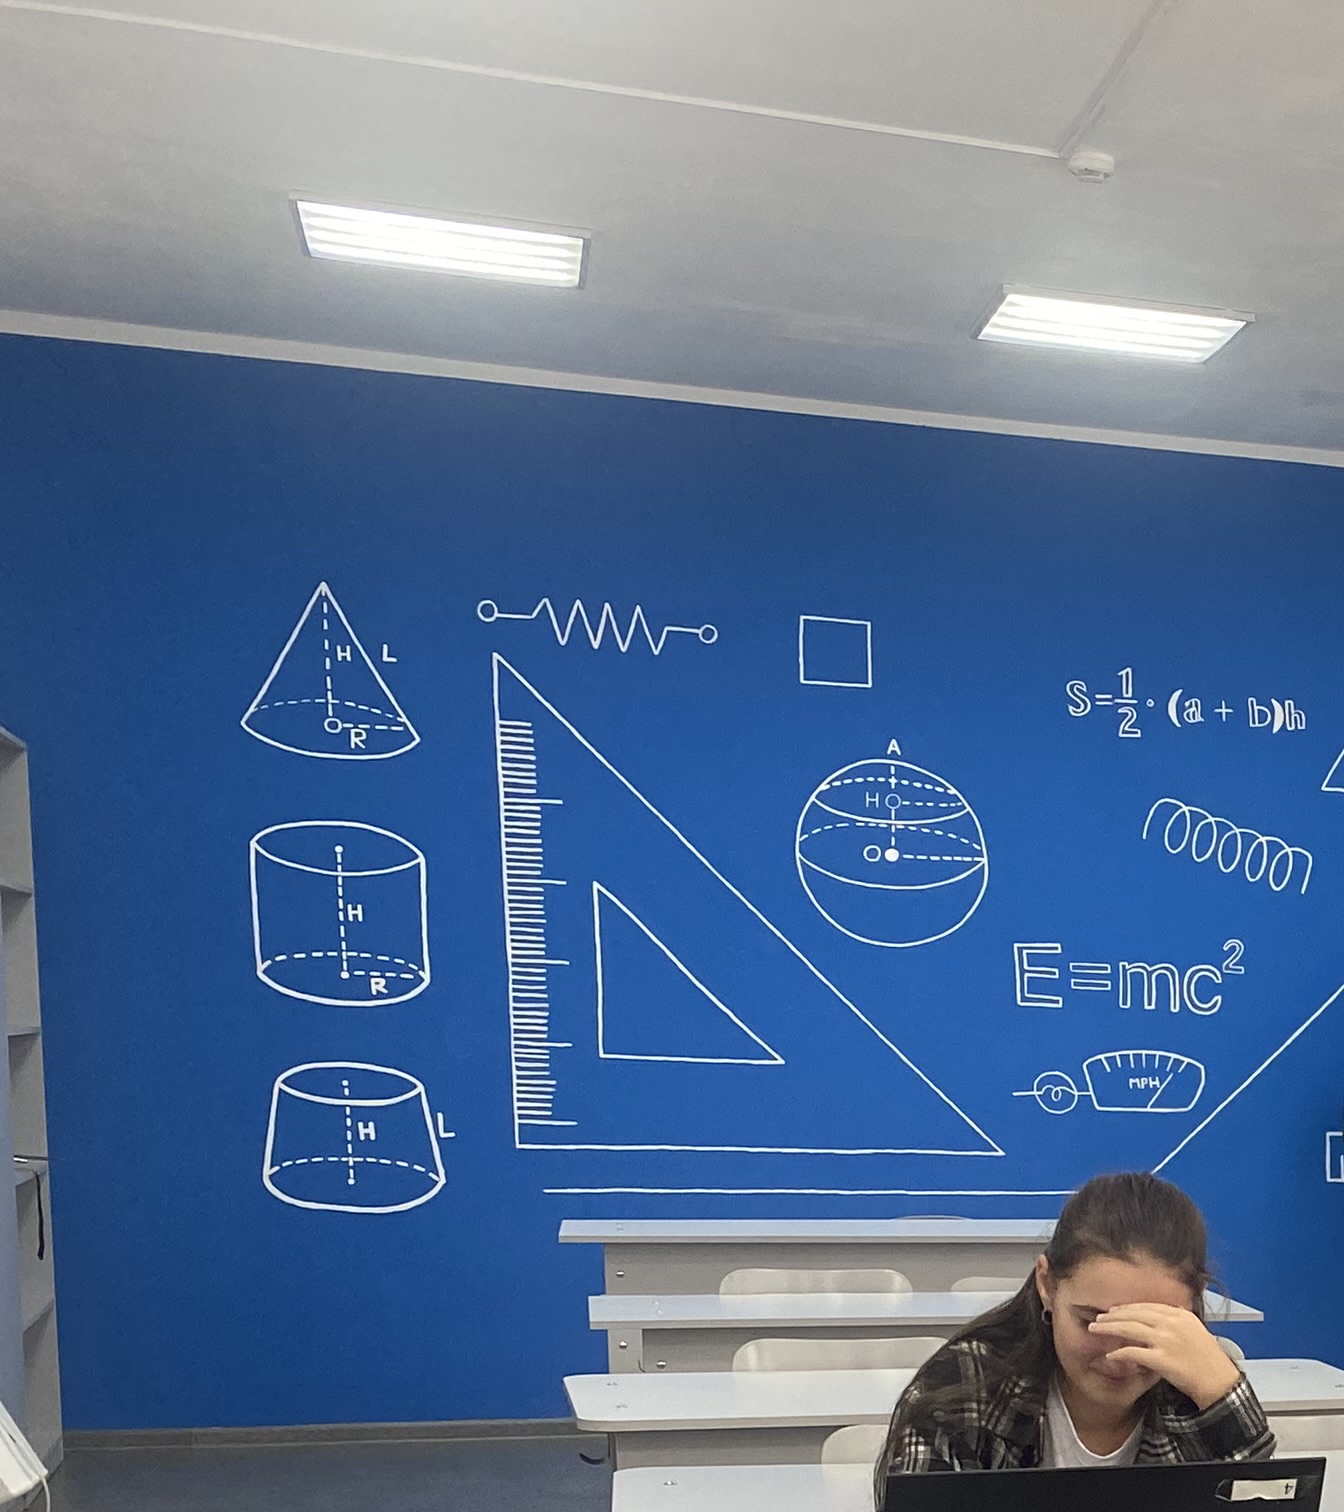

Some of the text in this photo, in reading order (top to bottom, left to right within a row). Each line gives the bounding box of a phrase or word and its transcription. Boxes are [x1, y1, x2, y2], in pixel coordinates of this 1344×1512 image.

[336, 645, 351, 662] H
[382, 643, 398, 662] L
[350, 728, 367, 749] R
[887, 738, 901, 756] A
[347, 903, 364, 922] H
[370, 977, 388, 995] R
[1129, 1077, 1160, 1089] MPH
[357, 1121, 376, 1141] H
[437, 1112, 456, 1138] L
